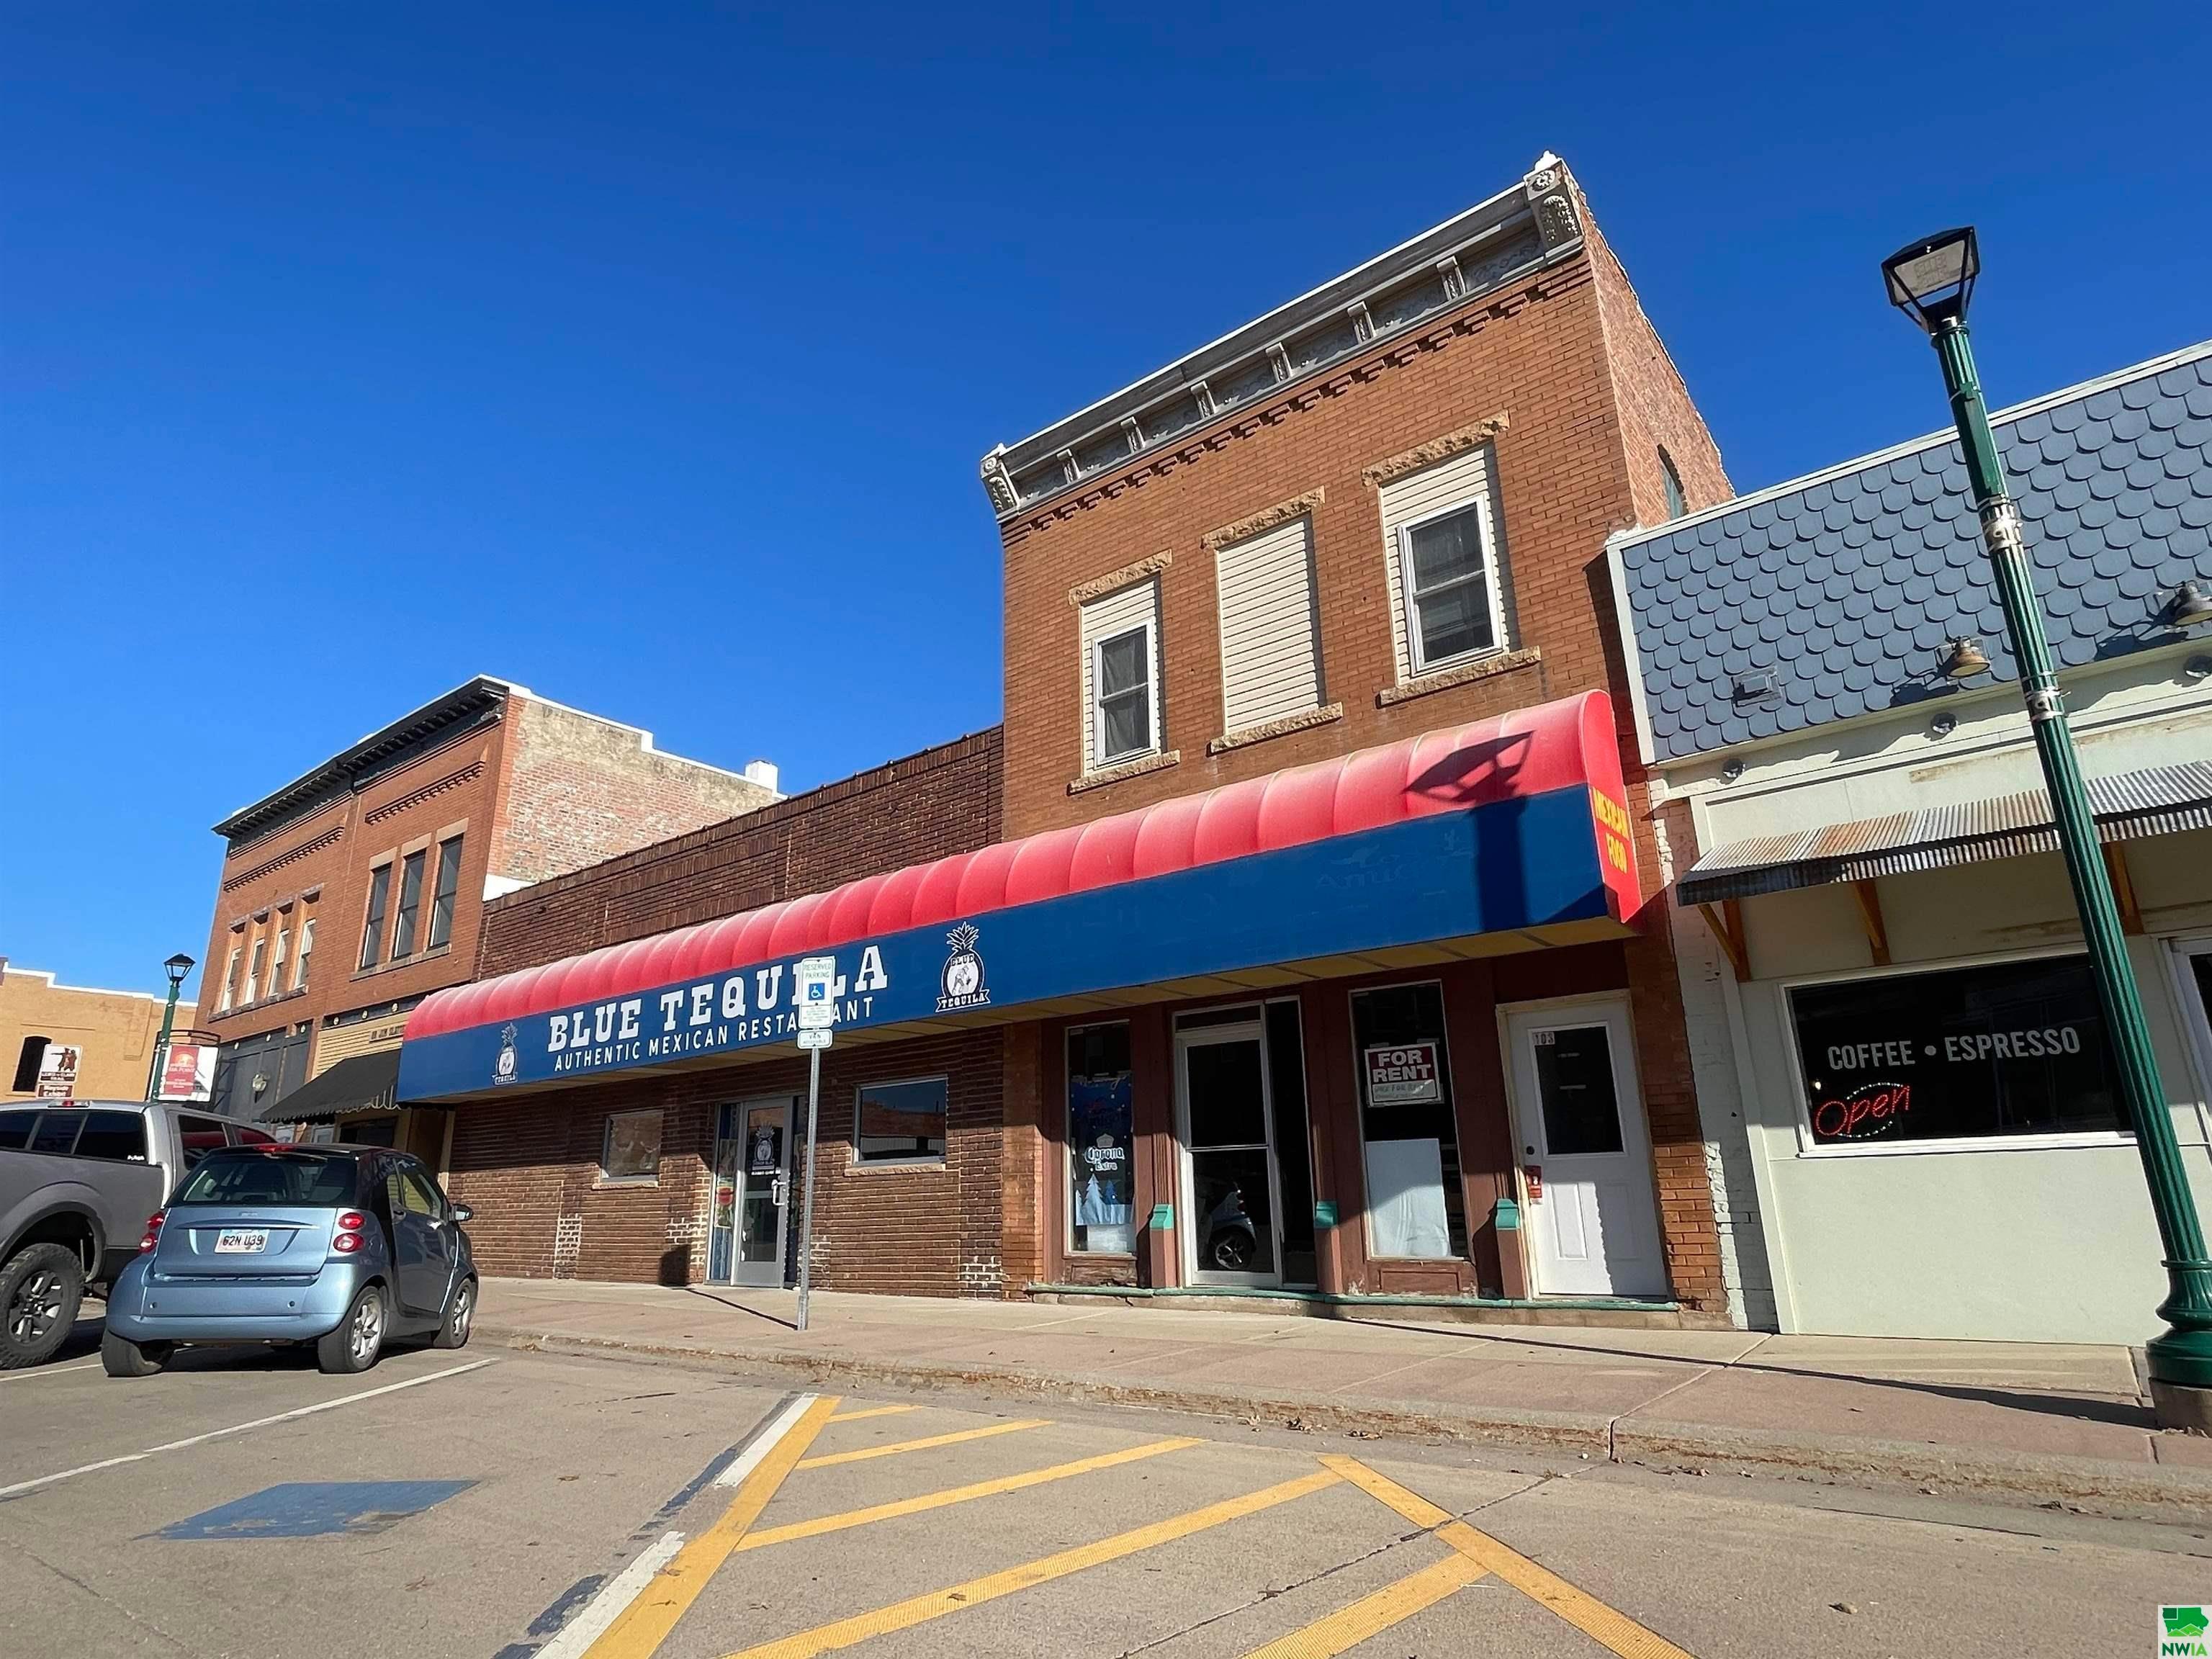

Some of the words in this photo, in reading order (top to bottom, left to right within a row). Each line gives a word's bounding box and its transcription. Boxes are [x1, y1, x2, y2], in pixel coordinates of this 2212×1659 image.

[1591, 786, 1629, 841] MEXICAN
[1605, 832, 1627, 874] FOOD
[804, 963, 832, 971] RESERVED
[950, 953, 974, 966] BLUE
[941, 993, 986, 1009] TEQUILA
[548, 998, 642, 1053] BLUE
[554, 1041, 641, 1072] AUTHENTIC
[648, 1025, 728, 1057] MEXICAN
[737, 996, 874, 1041] RESTAANT
[1535, 1033, 1554, 1044] 103
[1827, 1040, 1915, 1070] COFFEE
[1944, 1027, 2080, 1061] ESPRESSO
[1377, 1050, 1424, 1067] FOR
[1372, 1064, 1431, 1082] RENT
[1815, 1085, 1910, 1136] Open
[1084, 1146, 1125, 1164] Corona
[1094, 1161, 1118, 1172] Extra
